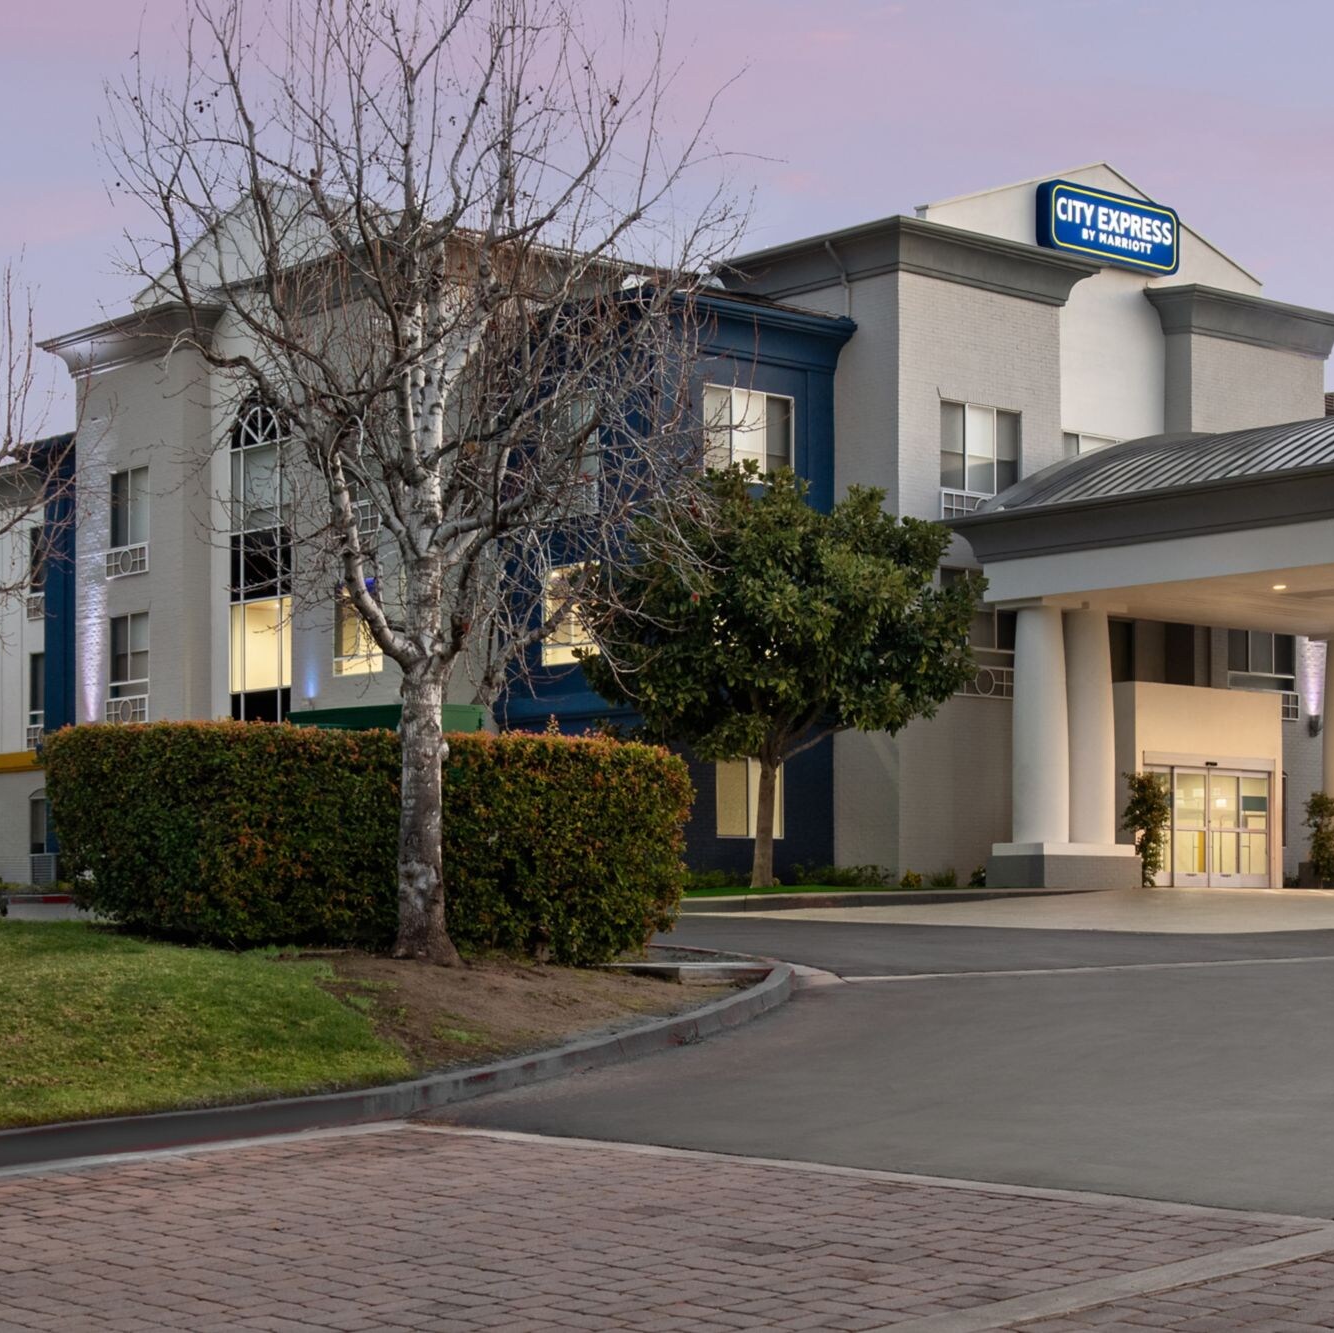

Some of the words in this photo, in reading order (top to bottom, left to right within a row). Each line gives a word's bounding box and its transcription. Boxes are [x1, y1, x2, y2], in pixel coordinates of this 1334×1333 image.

[1057, 197, 1094, 226] CITY
[1098, 207, 1172, 245] EXPRESS
[1082, 229, 1095, 241] BY
[1099, 233, 1152, 254] MARRIOTT
